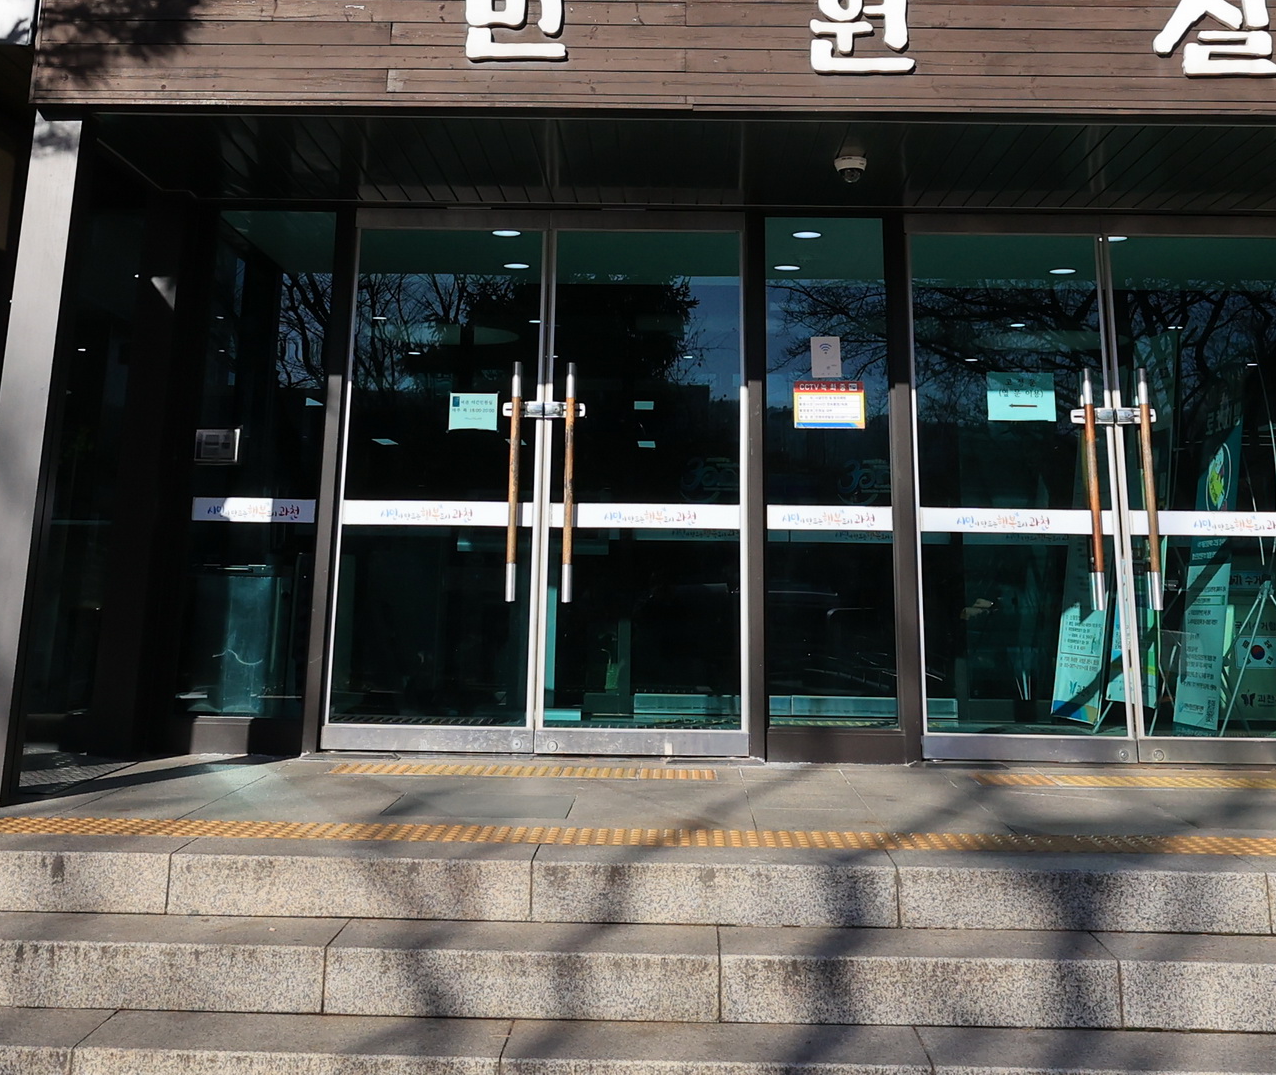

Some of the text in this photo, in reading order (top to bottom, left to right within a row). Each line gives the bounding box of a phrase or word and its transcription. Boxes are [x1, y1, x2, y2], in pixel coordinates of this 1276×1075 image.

[799, 383, 819, 391] CCTV
[278, 504, 299, 520] 과천
[452, 507, 473, 522] 과천
[676, 510, 697, 525] 과천
[854, 512, 876, 527] 과천
[1029, 515, 1051, 530] 과천
